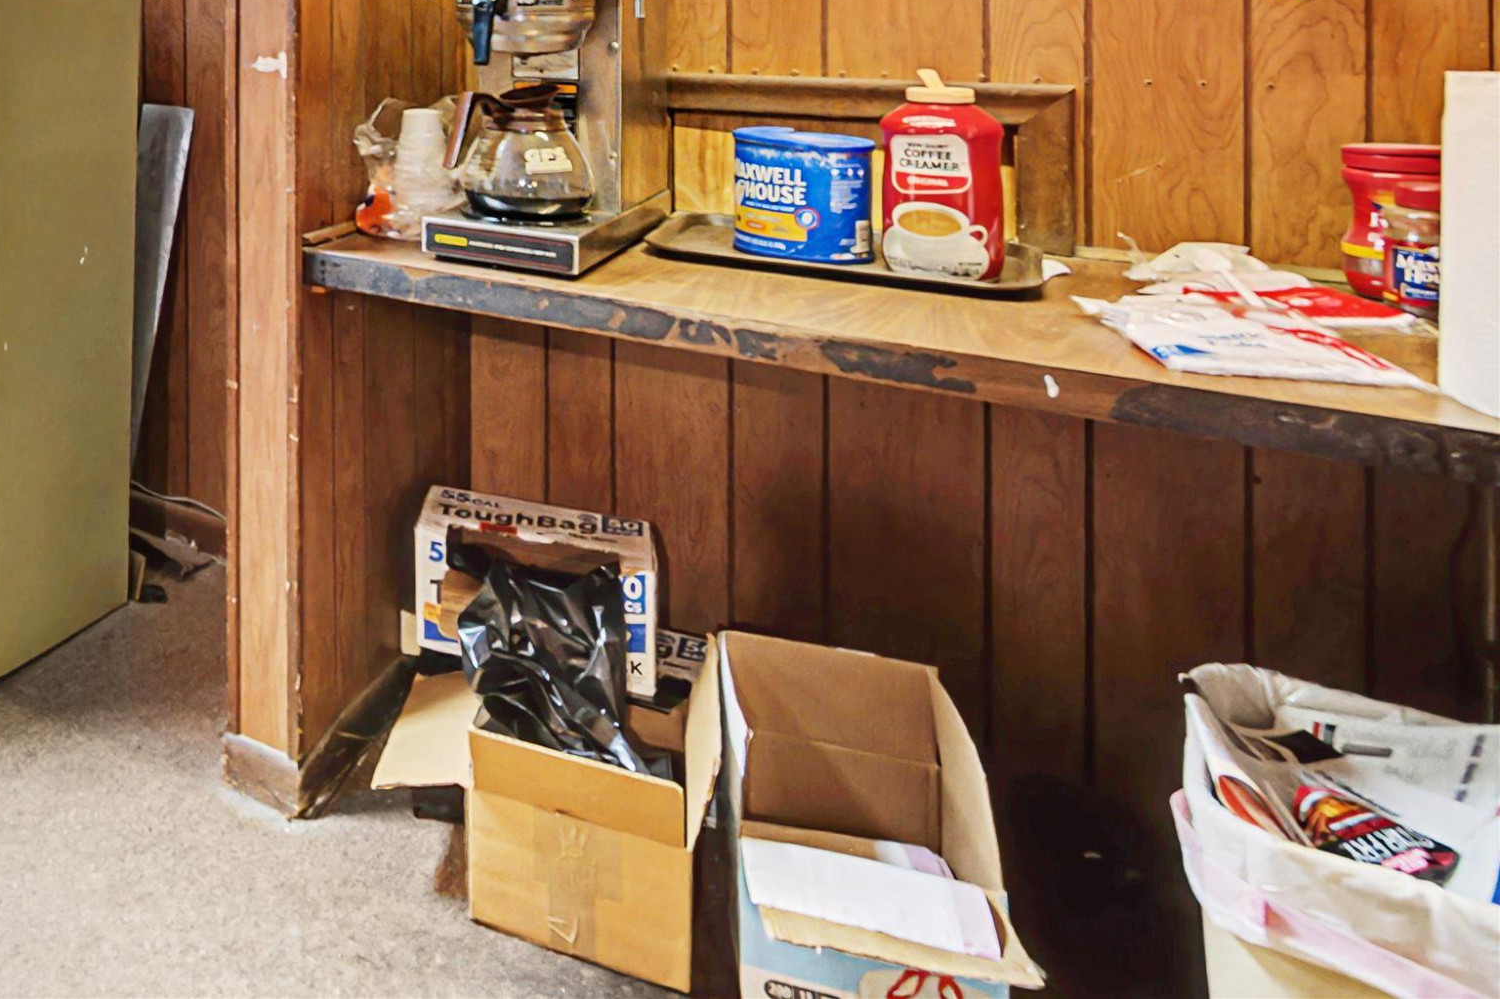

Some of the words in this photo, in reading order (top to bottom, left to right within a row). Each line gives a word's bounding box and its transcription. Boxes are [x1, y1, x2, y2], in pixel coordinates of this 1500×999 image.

[904, 148, 951, 160] COFFEE
[899, 158, 960, 171] CREAMER
[745, 180, 807, 206] HOUSE
[440, 503, 598, 534] ToughBag
